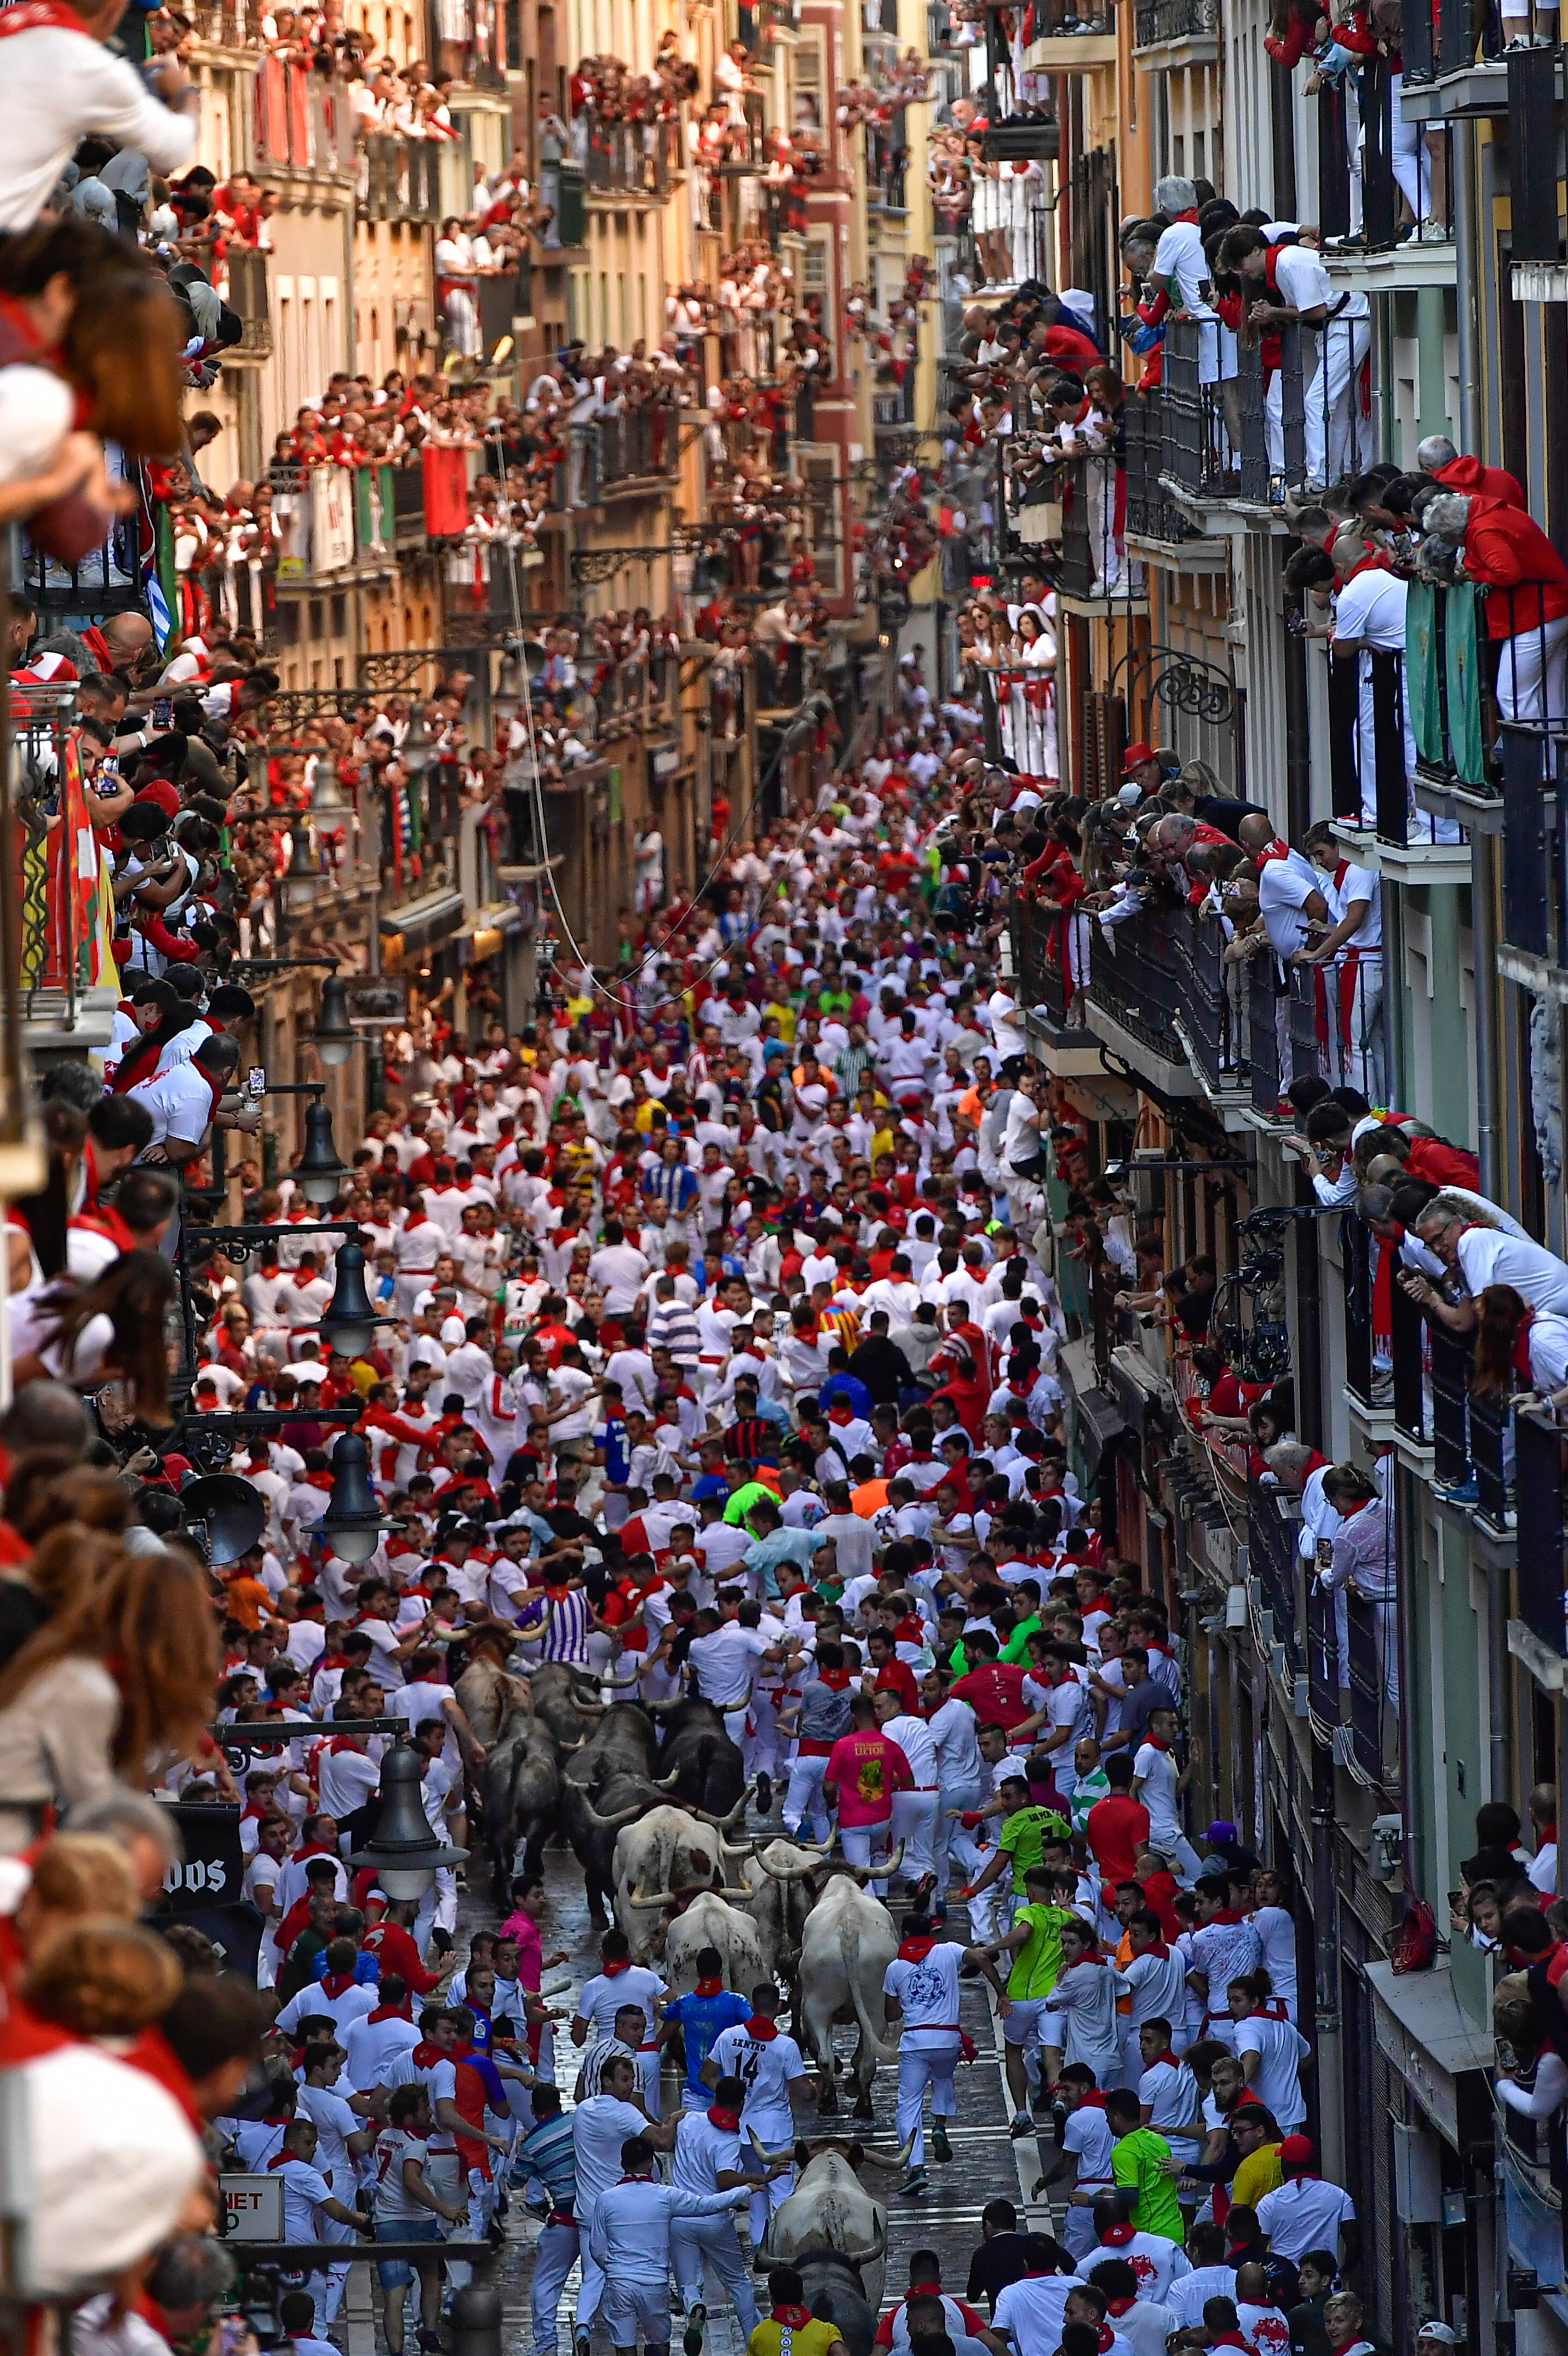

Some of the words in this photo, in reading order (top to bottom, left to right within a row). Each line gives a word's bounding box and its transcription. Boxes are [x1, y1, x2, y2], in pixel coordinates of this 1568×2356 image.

[732, 2038, 766, 2052] SANTXO
[735, 2050, 759, 2088] 14
[375, 2148, 392, 2184] 7
